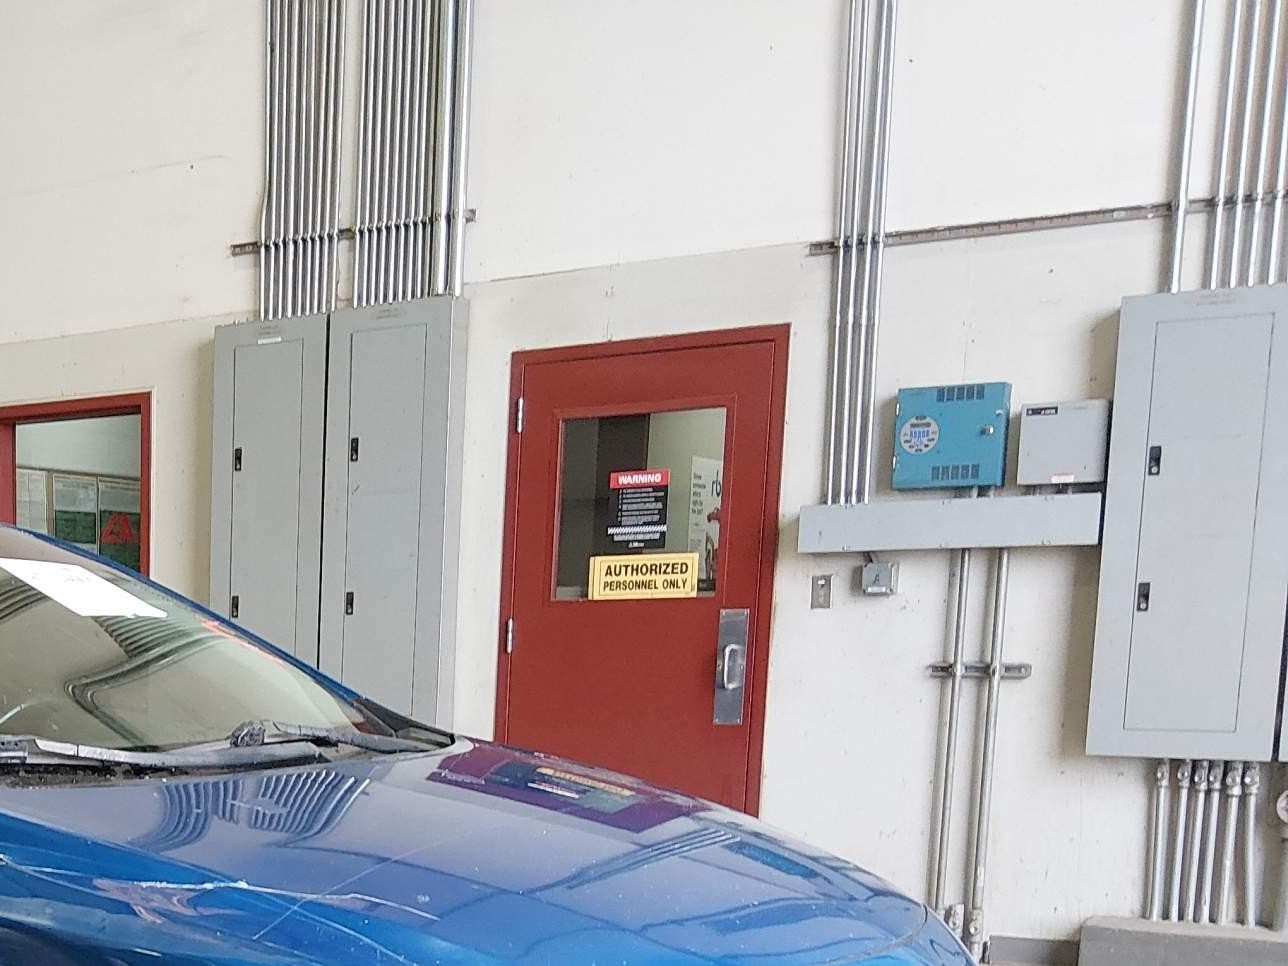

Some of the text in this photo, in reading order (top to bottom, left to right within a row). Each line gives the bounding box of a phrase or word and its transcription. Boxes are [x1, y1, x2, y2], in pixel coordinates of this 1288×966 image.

[617, 472, 662, 486] WARNING
[604, 562, 689, 577] AUTHORIZED
[602, 577, 688, 592] PERSONNEL ONLY
